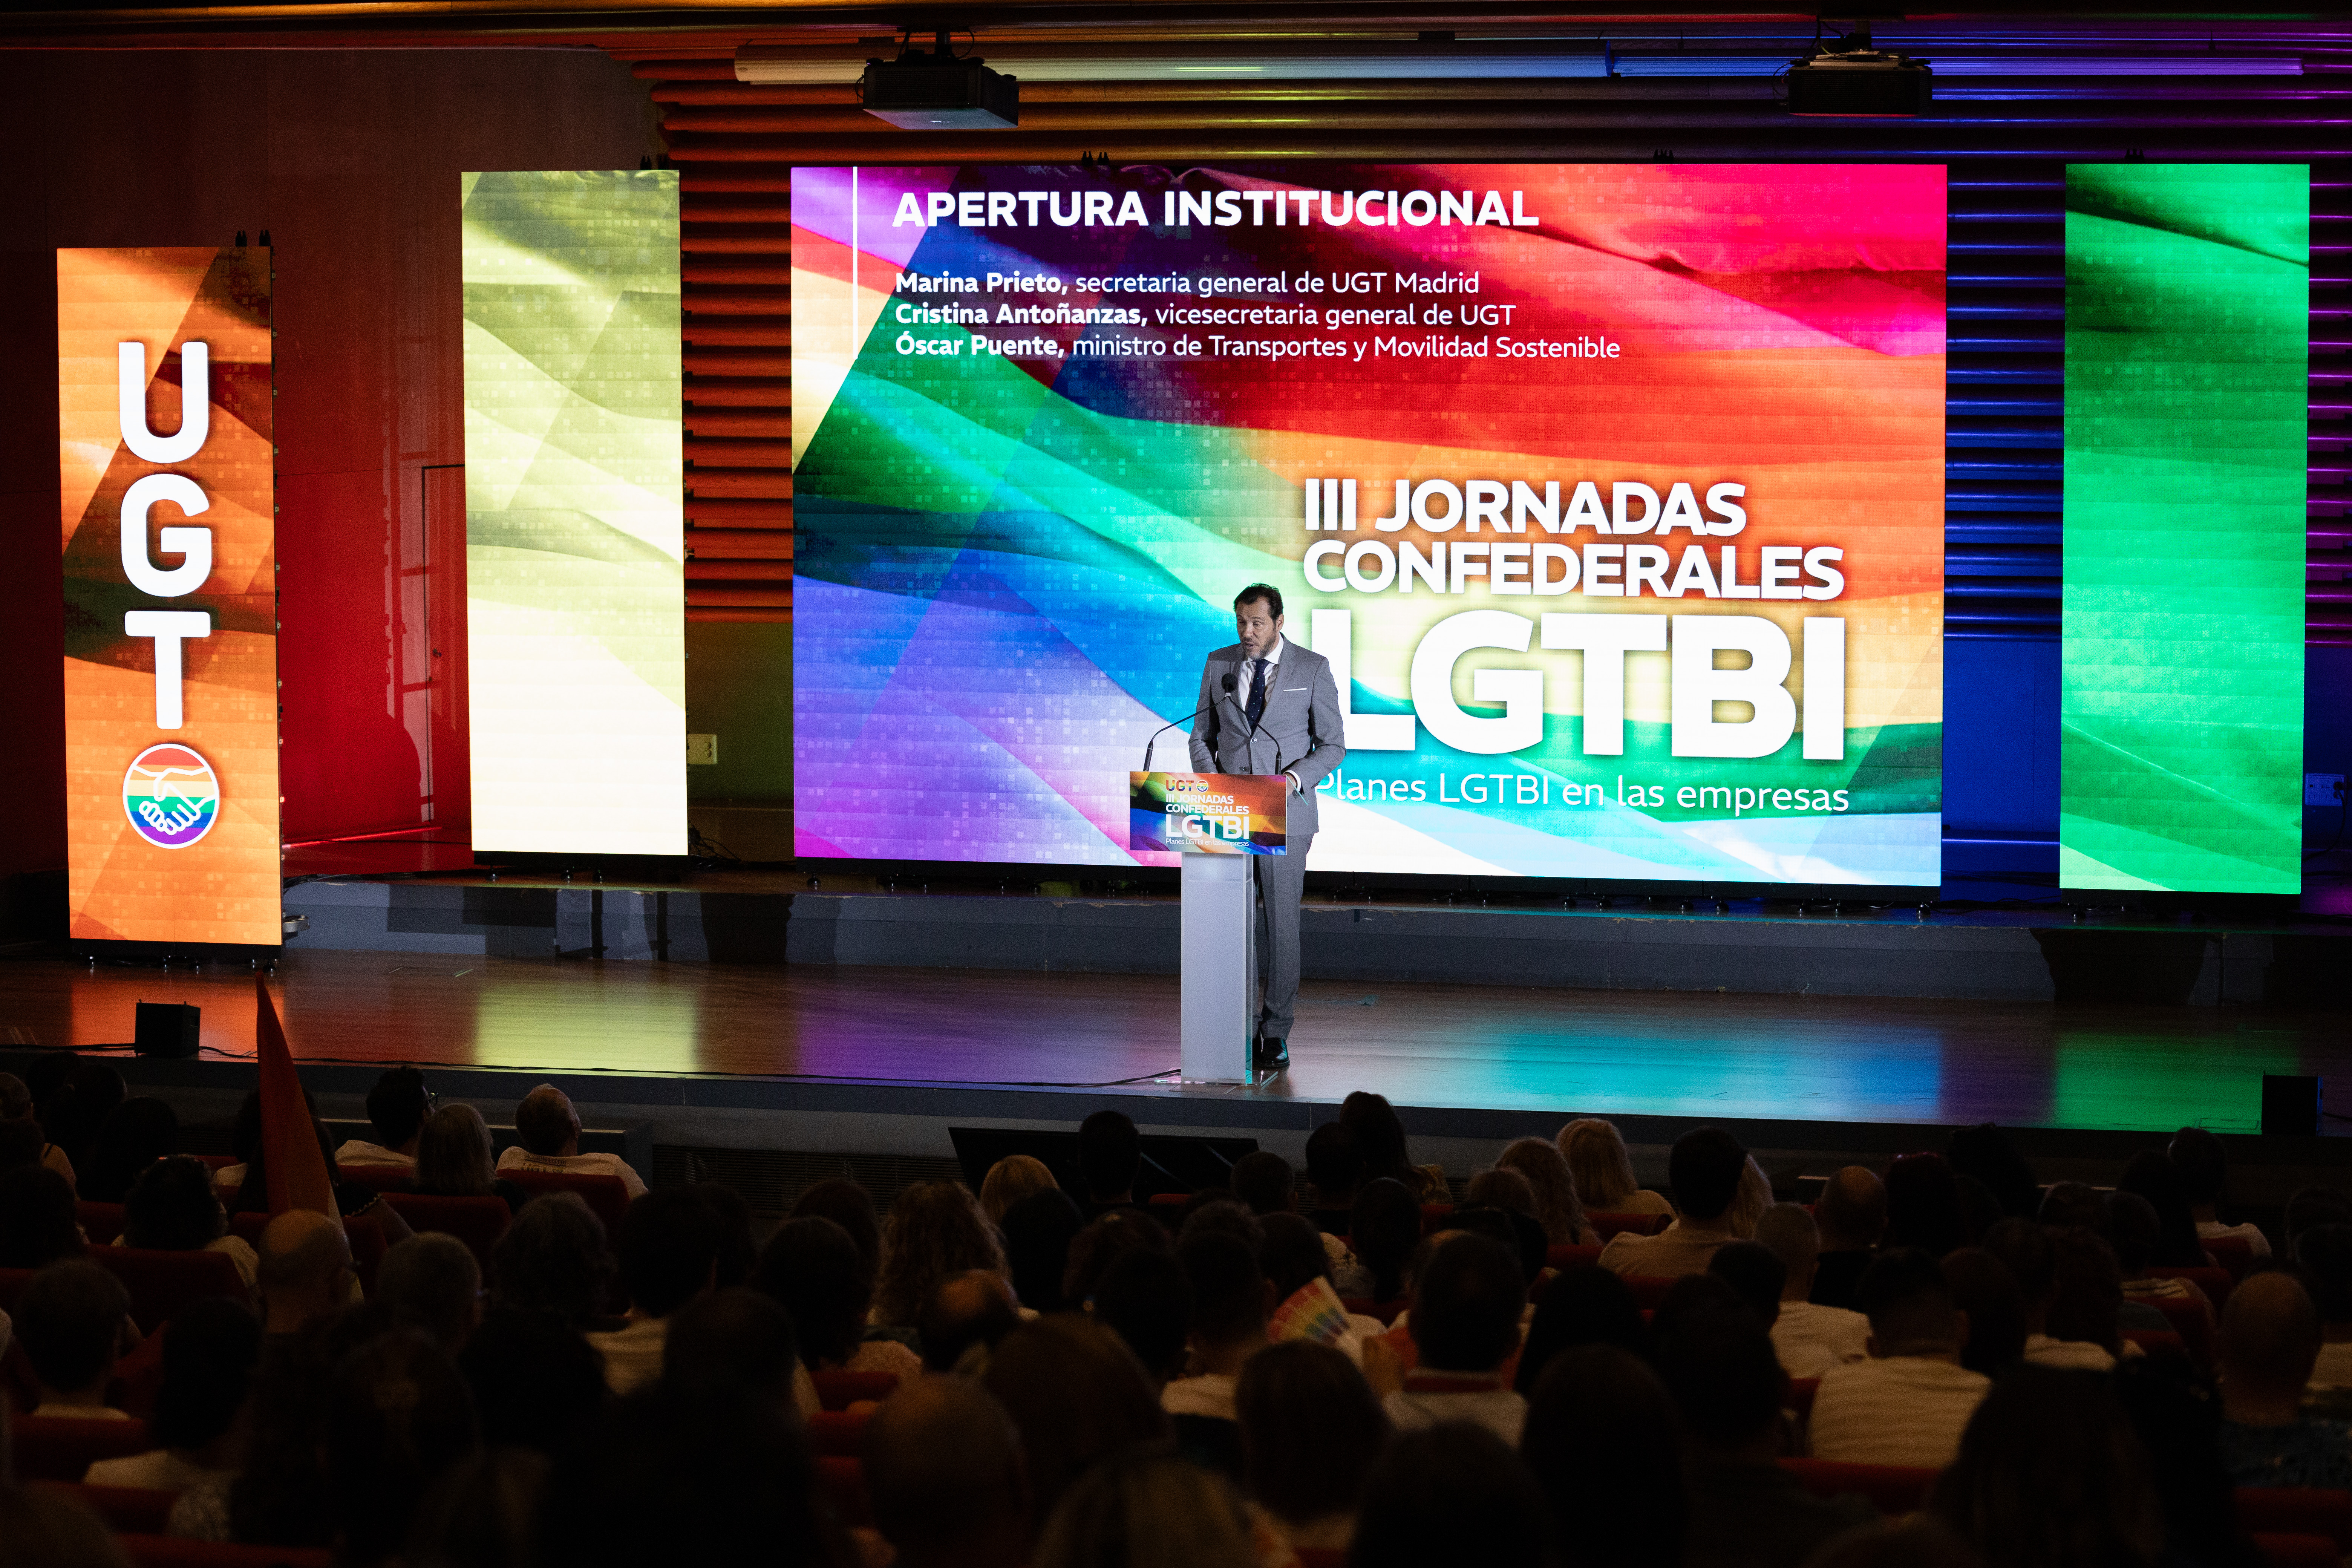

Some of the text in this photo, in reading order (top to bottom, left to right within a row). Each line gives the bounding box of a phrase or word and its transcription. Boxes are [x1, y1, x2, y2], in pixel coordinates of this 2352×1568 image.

[892, 190, 1539, 227] APERTURA INSTITUCIONAL
[896, 270, 1478, 298] Marina Prieto, secretaria general de UGT Madrid
[896, 302, 1516, 330] Cristina Antoñanzas, vicesecretaria general de UGT
[896, 331, 1620, 362] Óscar Puente, ministro de Transportes y Movilidad Sostenible
[1305, 478, 1746, 536] III JORNADAS
[118, 341, 212, 730] UGT
[1304, 540, 1844, 600] CONFEDERALES
[1312, 609, 1844, 760] LGTBI
[1166, 779, 1194, 791] UGT
[1166, 794, 1234, 804] III JORNADAS
[1440, 773, 1548, 804] LGTBI
[1562, 784, 1603, 805] en
[1618, 775, 1664, 807] las
[1677, 785, 1849, 816] empresas
[1166, 804, 1249, 815] CONFEDERALES
[1166, 814, 1249, 839] LGTBI
